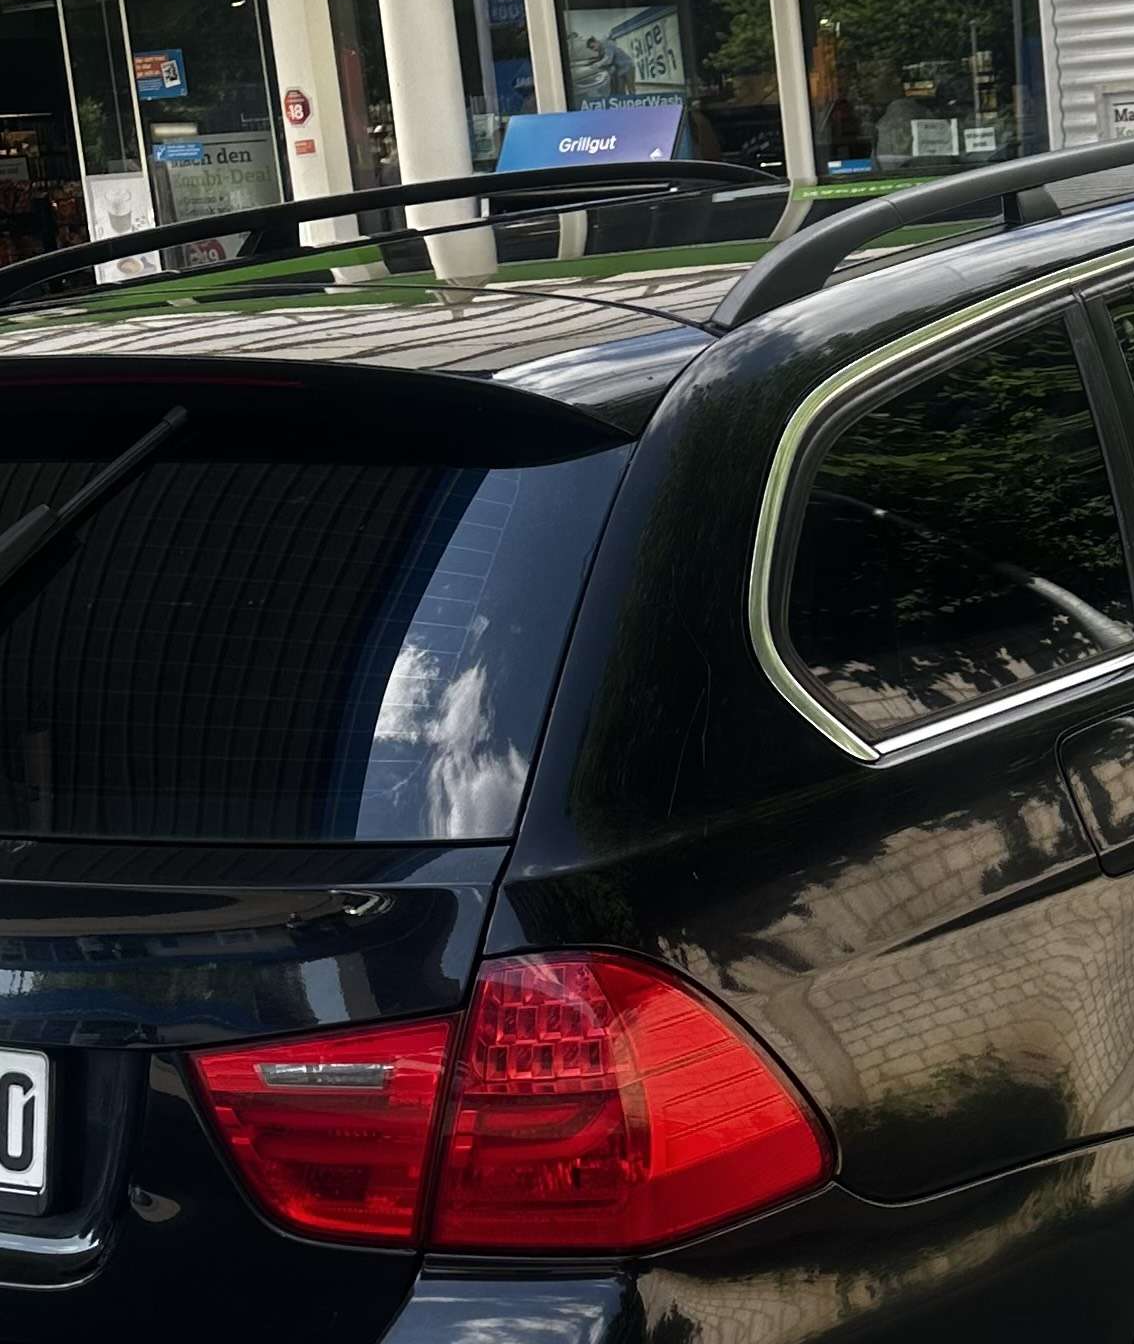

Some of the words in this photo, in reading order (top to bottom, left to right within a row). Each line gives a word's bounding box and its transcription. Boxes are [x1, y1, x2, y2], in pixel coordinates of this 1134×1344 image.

[287, 103, 304, 121] 18
[581, 98, 606, 112] Aral
[609, 94, 683, 111] SuperWash
[558, 135, 617, 154] Grillgut
[217, 147, 253, 164] den
